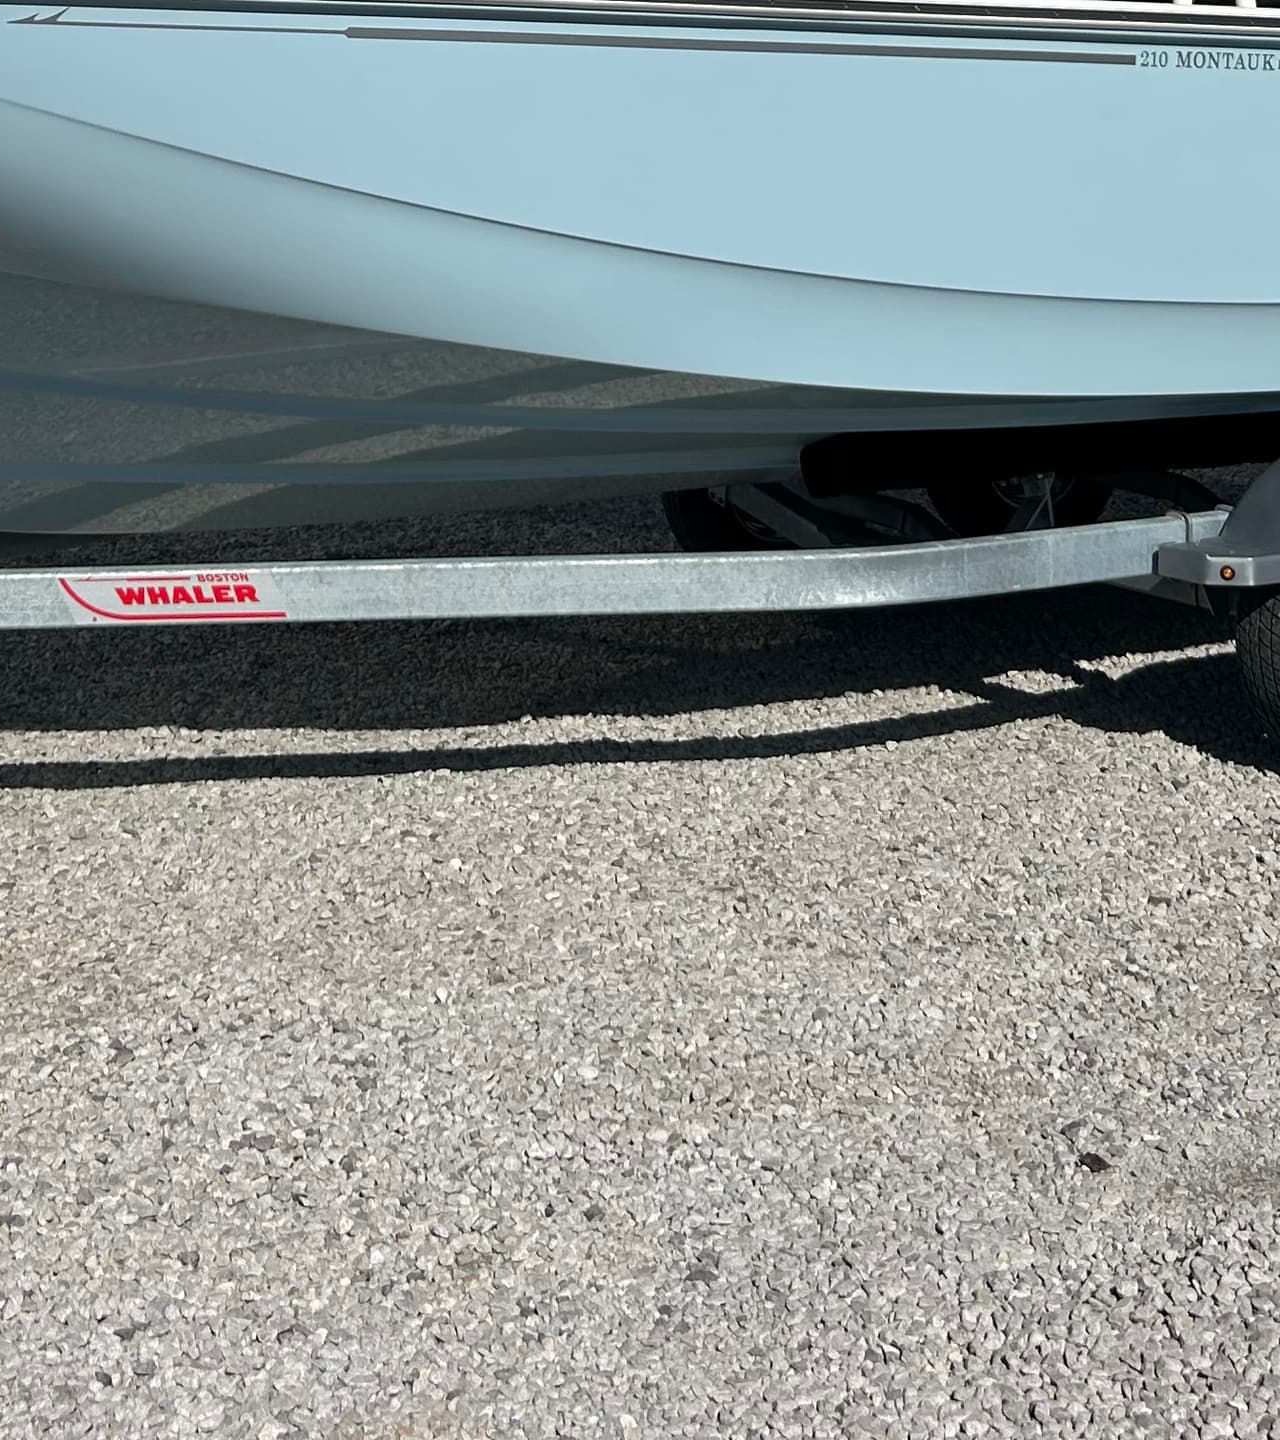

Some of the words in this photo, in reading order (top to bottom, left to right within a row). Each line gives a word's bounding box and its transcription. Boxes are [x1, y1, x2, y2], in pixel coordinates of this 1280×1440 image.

[1139, 50, 1169, 68] 210
[1175, 50, 1276, 71] MONTAUK
[196, 572, 249, 583] BOSTON
[115, 584, 260, 606] WHALER
